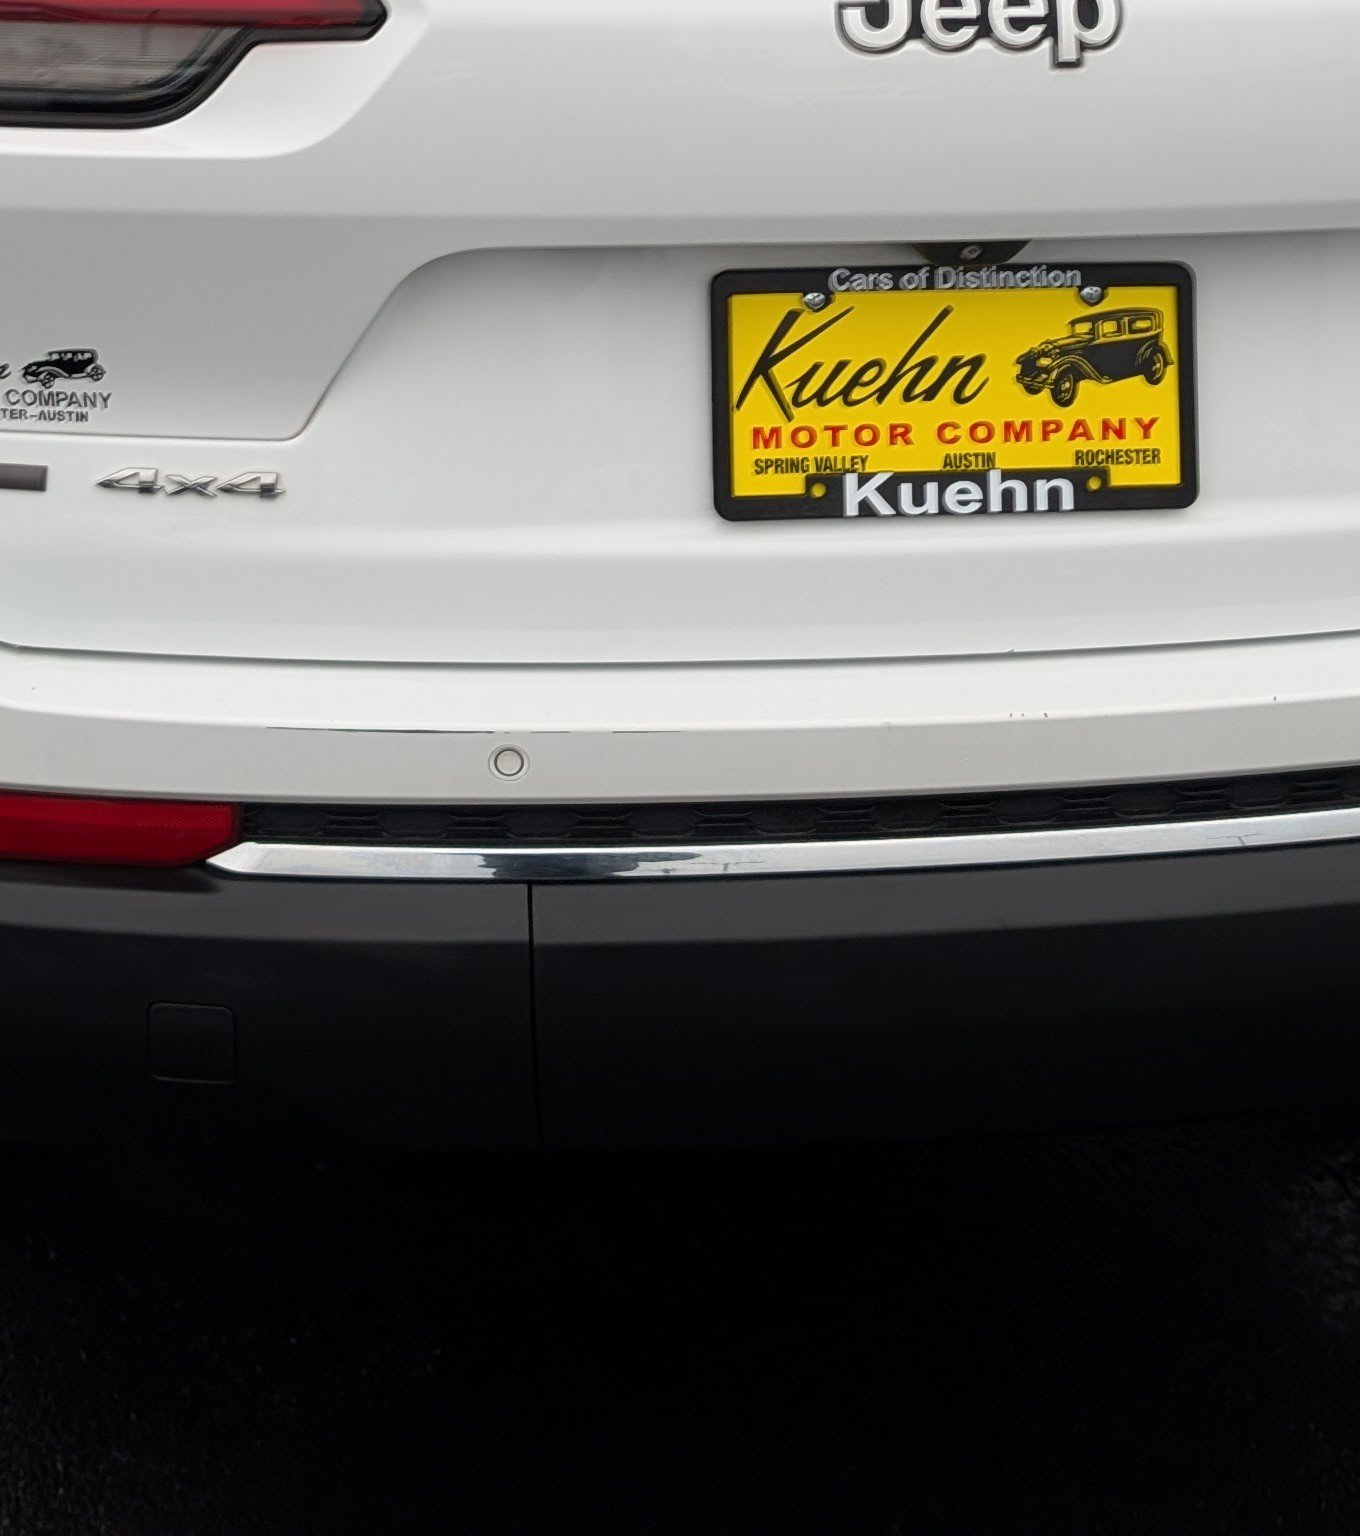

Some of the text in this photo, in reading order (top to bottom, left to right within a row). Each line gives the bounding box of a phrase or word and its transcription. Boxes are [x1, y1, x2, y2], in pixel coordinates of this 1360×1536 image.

[828, 264, 1082, 291] Cars of Distinction
[734, 304, 989, 422] Kuehn
[5, 388, 113, 409] COMPANY
[752, 416, 1160, 450] MOTOR COMPANY
[754, 454, 869, 475] SPRING VALLEY
[942, 451, 996, 469] AUSTIN
[1074, 447, 1162, 466] ROCHESTER
[94, 466, 286, 499] 4x4
[842, 468, 1075, 517] Kuehn
